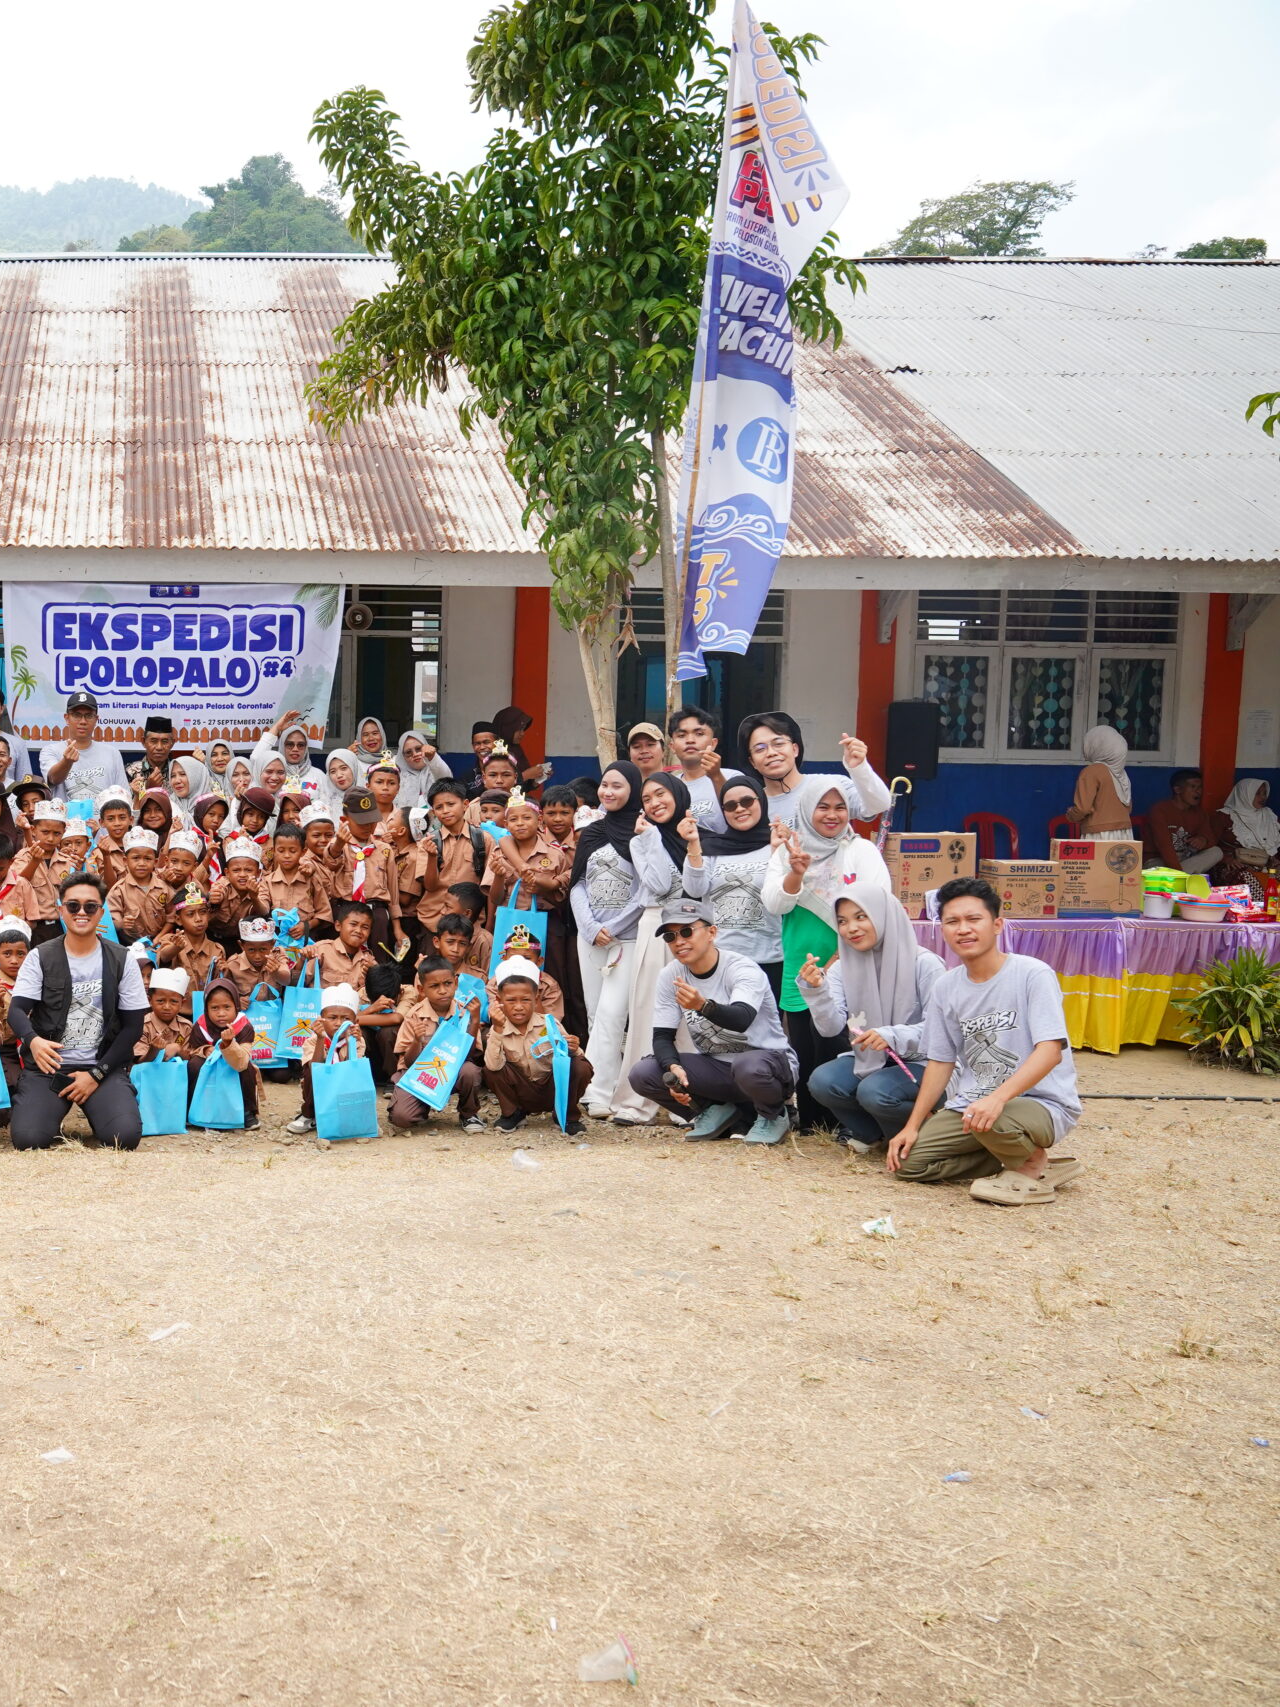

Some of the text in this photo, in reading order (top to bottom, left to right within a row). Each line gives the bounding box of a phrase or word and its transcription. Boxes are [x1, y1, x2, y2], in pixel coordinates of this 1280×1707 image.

[52, 612, 294, 652] EKSPEDISI
[64, 656, 293, 689] POLOPALO #4
[142, 702, 167, 710] Rupiah
[170, 702, 203, 711] Menyapa
[206, 702, 234, 710] Pelosok
[711, 862, 768, 880] EKSPEDIS
[1009, 865, 1053, 873] SHIMIZU
